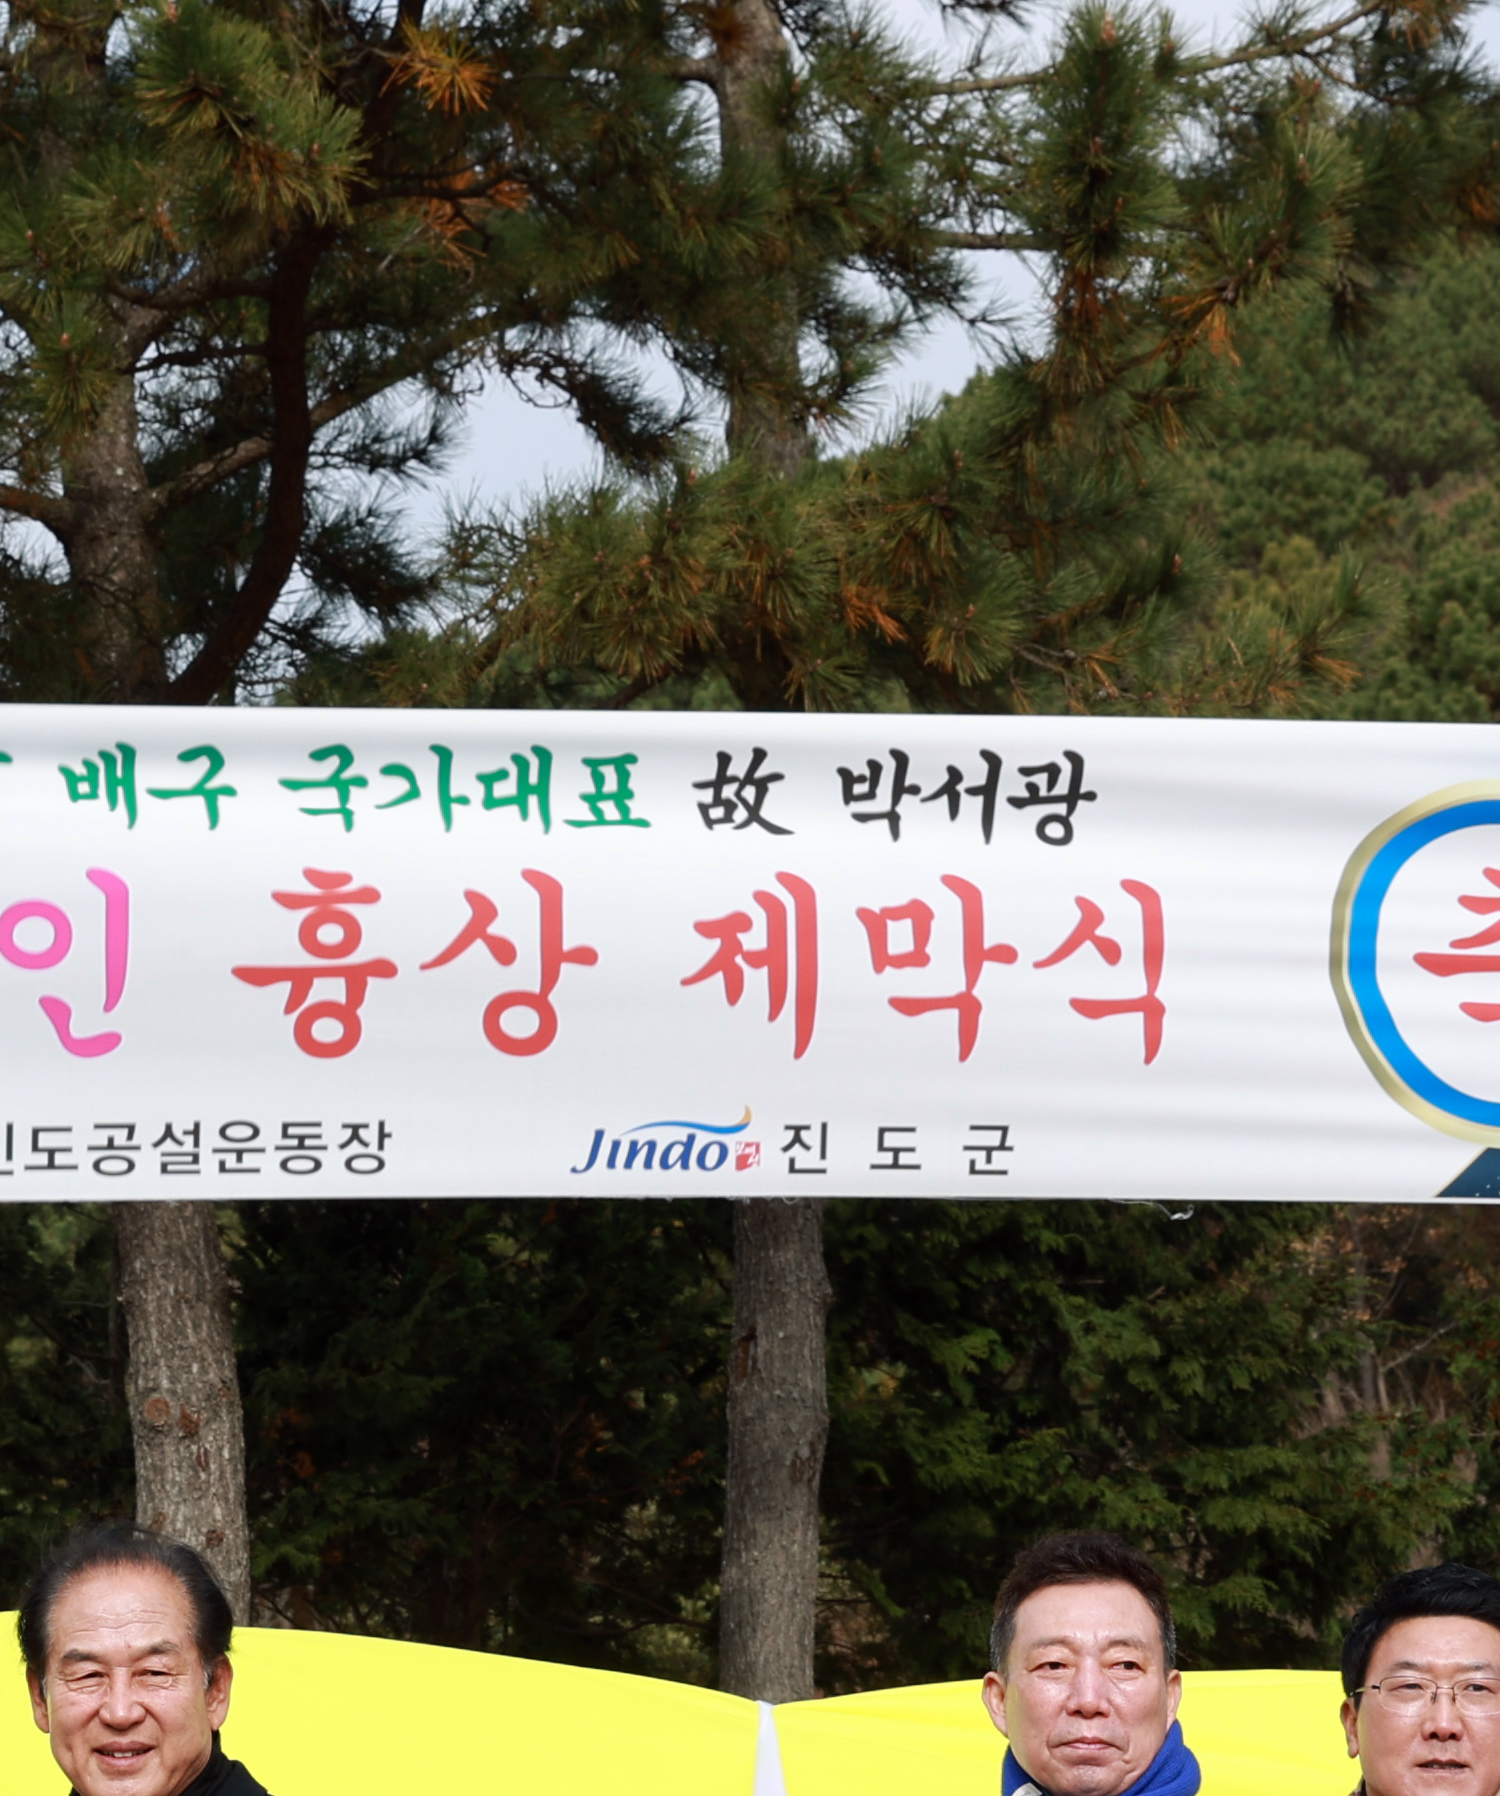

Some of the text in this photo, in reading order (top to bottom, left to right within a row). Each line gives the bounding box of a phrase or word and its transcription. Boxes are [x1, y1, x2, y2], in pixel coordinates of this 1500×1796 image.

[57, 740, 238, 831] 배구
[278, 742, 652, 834] 국가대표
[691, 745, 793, 836] 故
[835, 747, 1098, 847] 박서광
[230, 868, 599, 1060] 흉상
[679, 871, 1167, 1066] 제막식
[570, 1127, 730, 1175] Jindo
